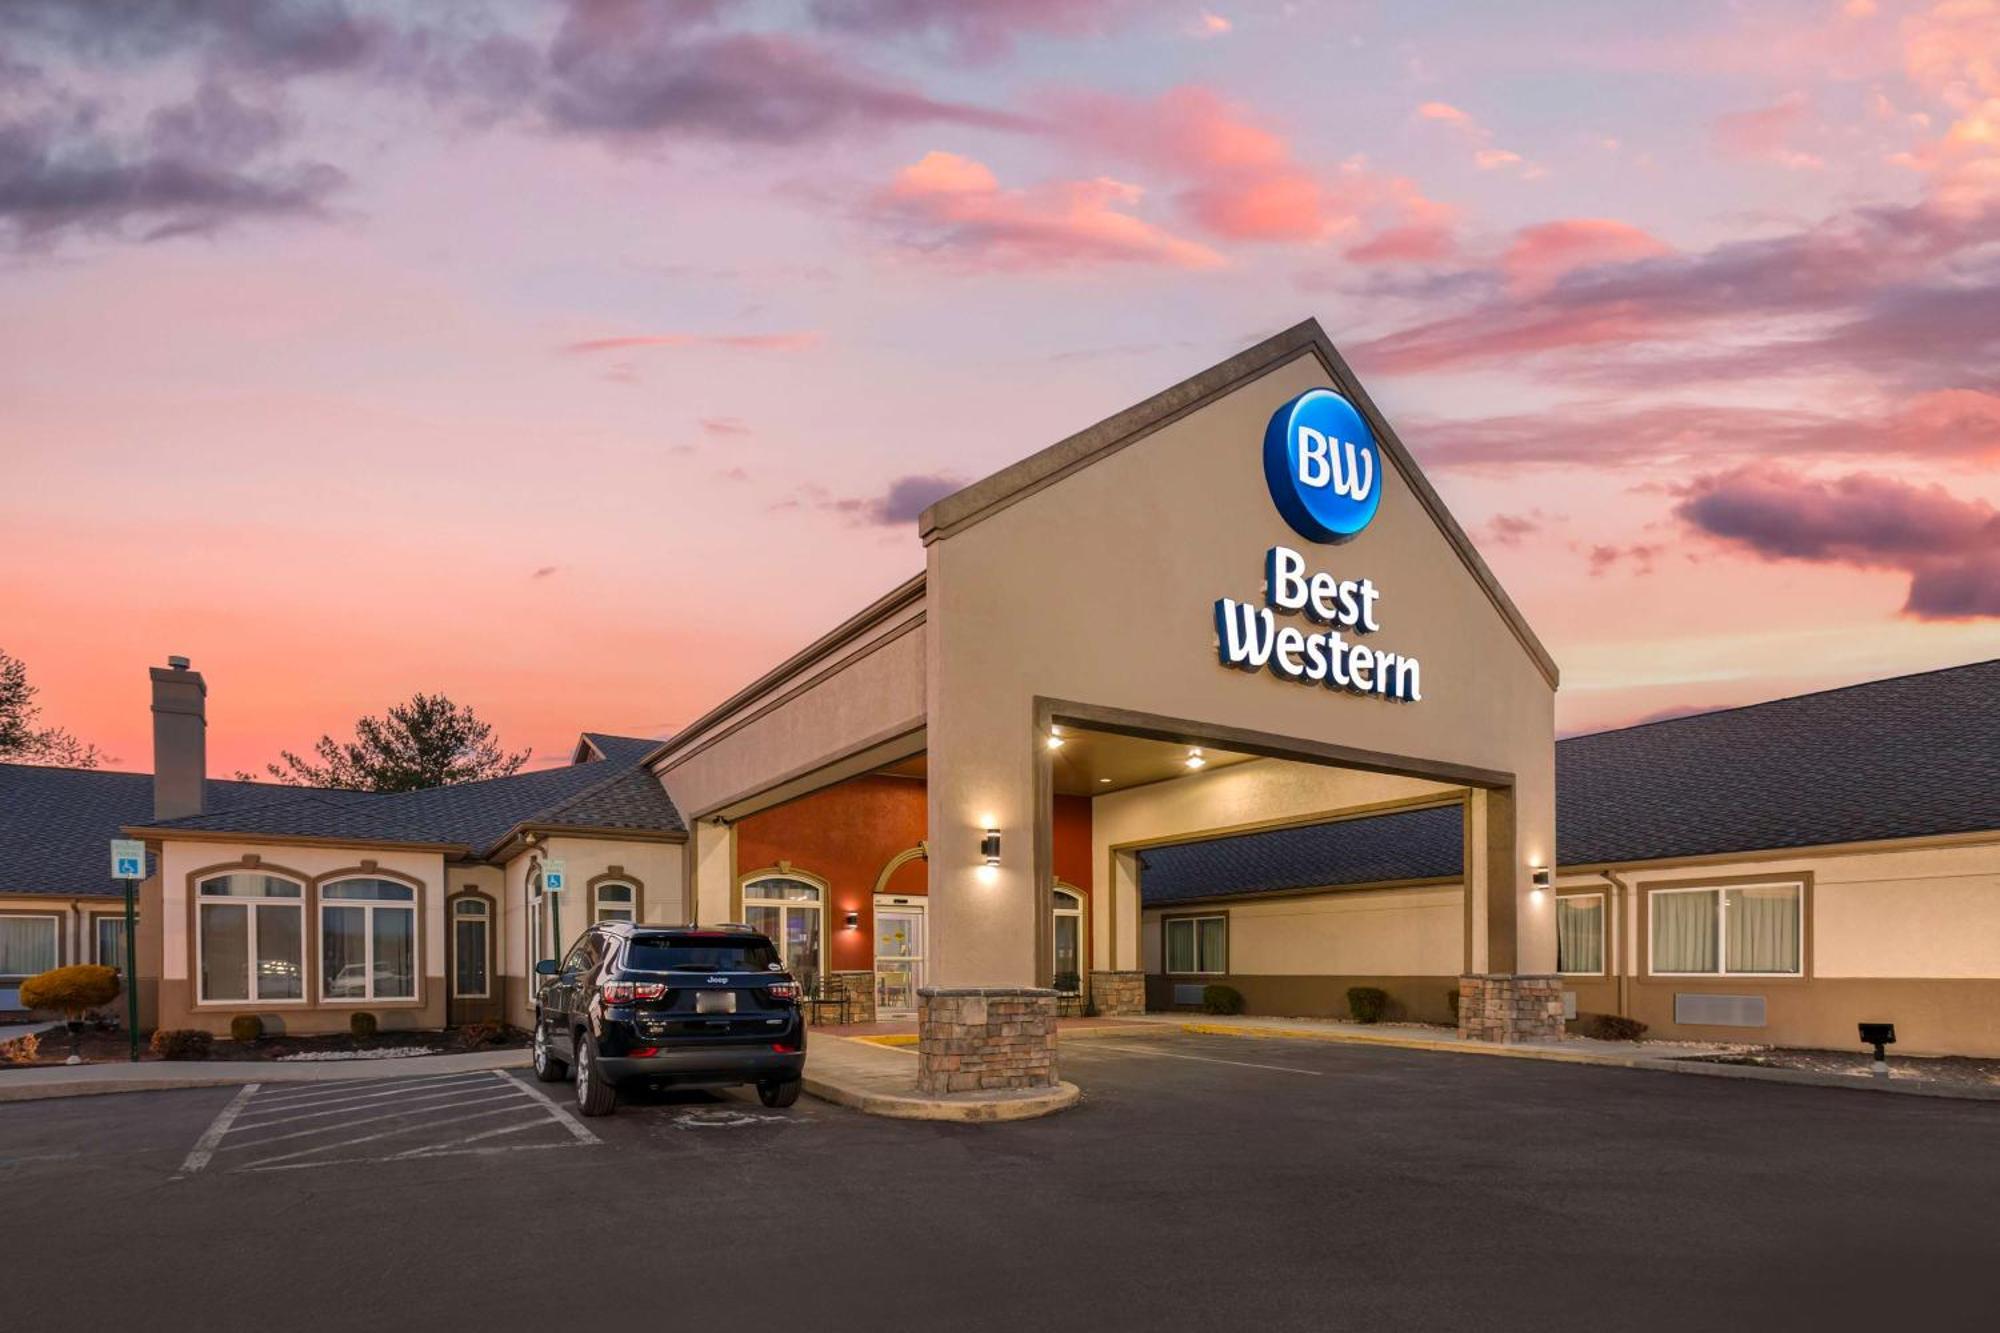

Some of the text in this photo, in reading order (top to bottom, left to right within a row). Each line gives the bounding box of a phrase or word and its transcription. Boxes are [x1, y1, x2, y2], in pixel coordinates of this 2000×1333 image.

[1298, 426, 1373, 501] BW
[1270, 546, 1379, 633] Best
[1219, 598, 1422, 701] Western
[707, 976, 729, 985] Jeep
